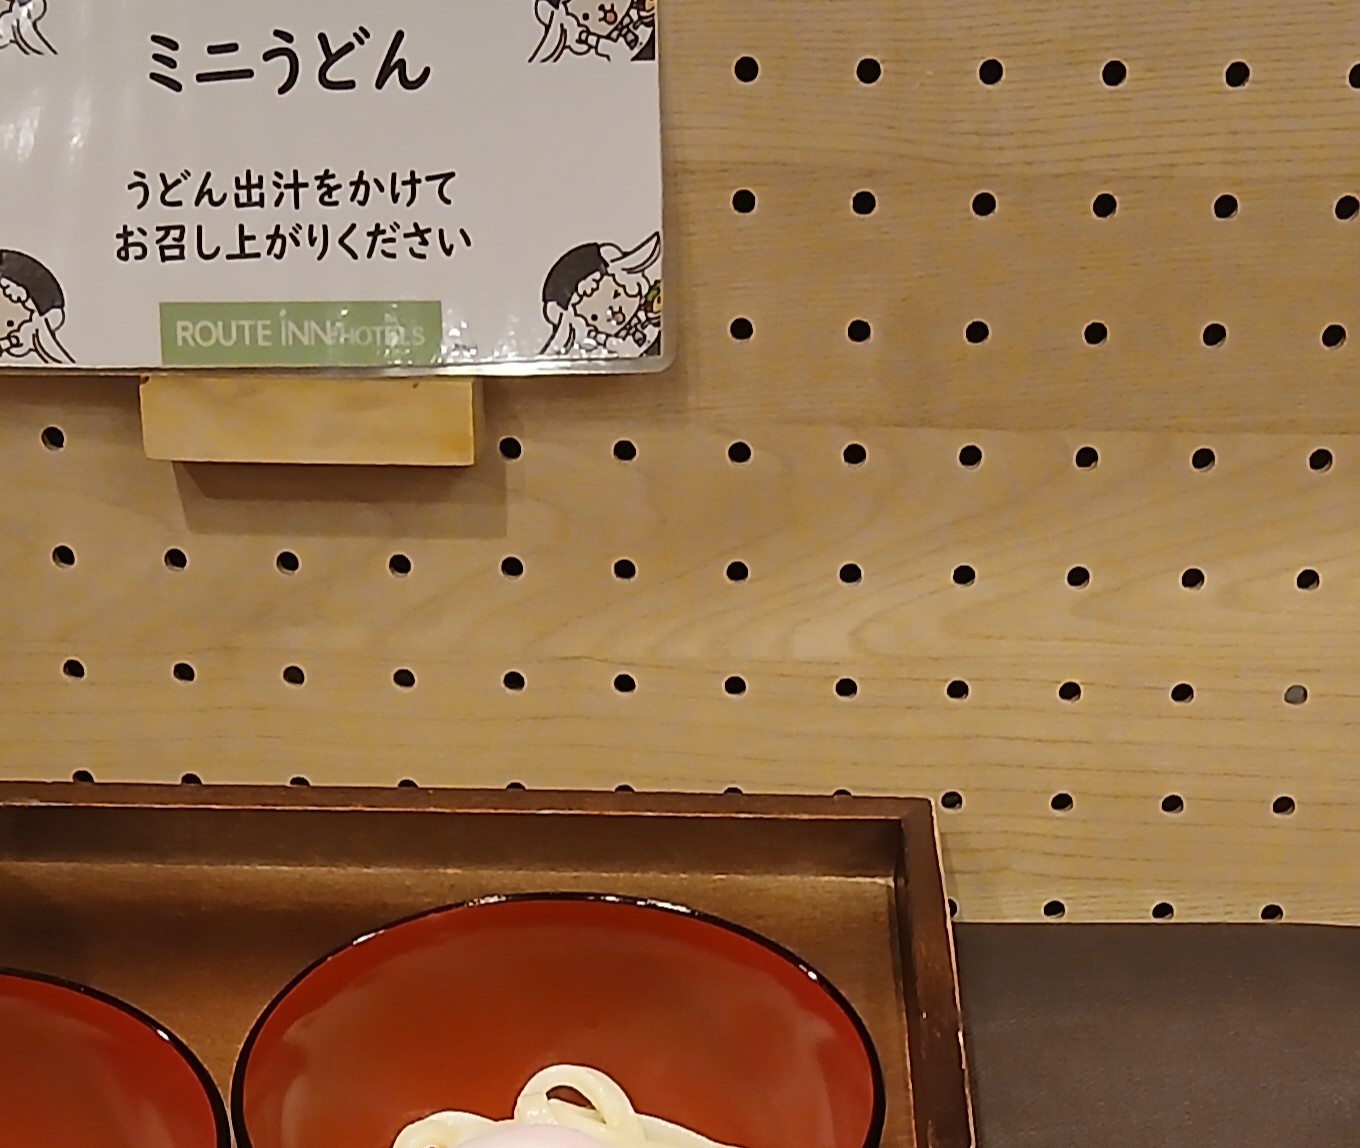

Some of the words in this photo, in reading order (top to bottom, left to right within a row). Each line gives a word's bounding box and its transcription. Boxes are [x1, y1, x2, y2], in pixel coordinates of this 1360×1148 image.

[148, 28, 432, 95] ミニうどん
[126, 167, 458, 211] うどん出汁をかけて
[115, 222, 472, 263] お召し上がりください
[176, 320, 272, 347] ROUTE
[341, 325, 426, 347] HOTELS
